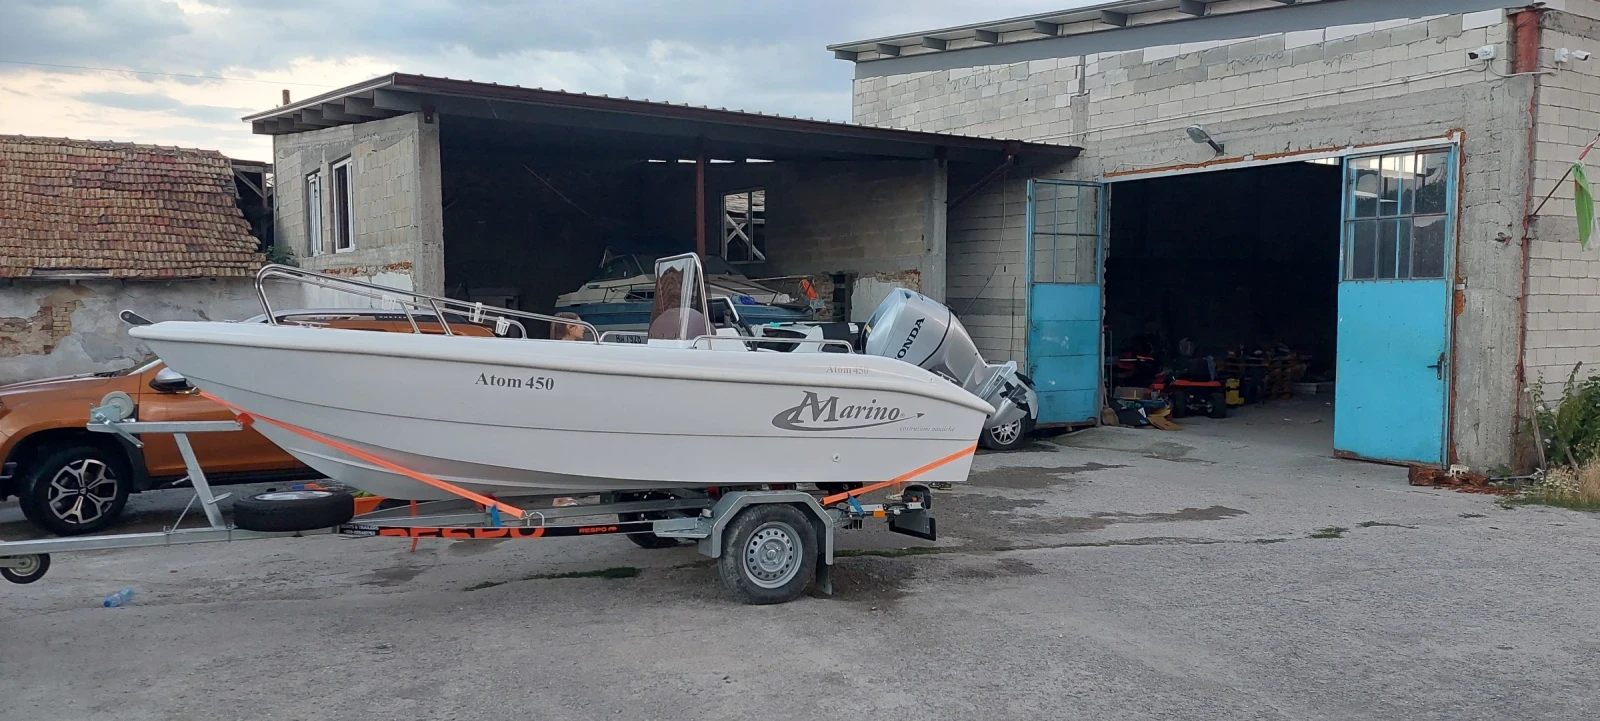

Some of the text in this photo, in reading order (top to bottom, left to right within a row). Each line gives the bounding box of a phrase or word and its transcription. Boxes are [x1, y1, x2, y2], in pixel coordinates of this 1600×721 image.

[896, 318, 925, 359] ONDA
[475, 372, 555, 391] Atom 450
[826, 365, 869, 375] Atom 450
[788, 390, 900, 421] Marino
